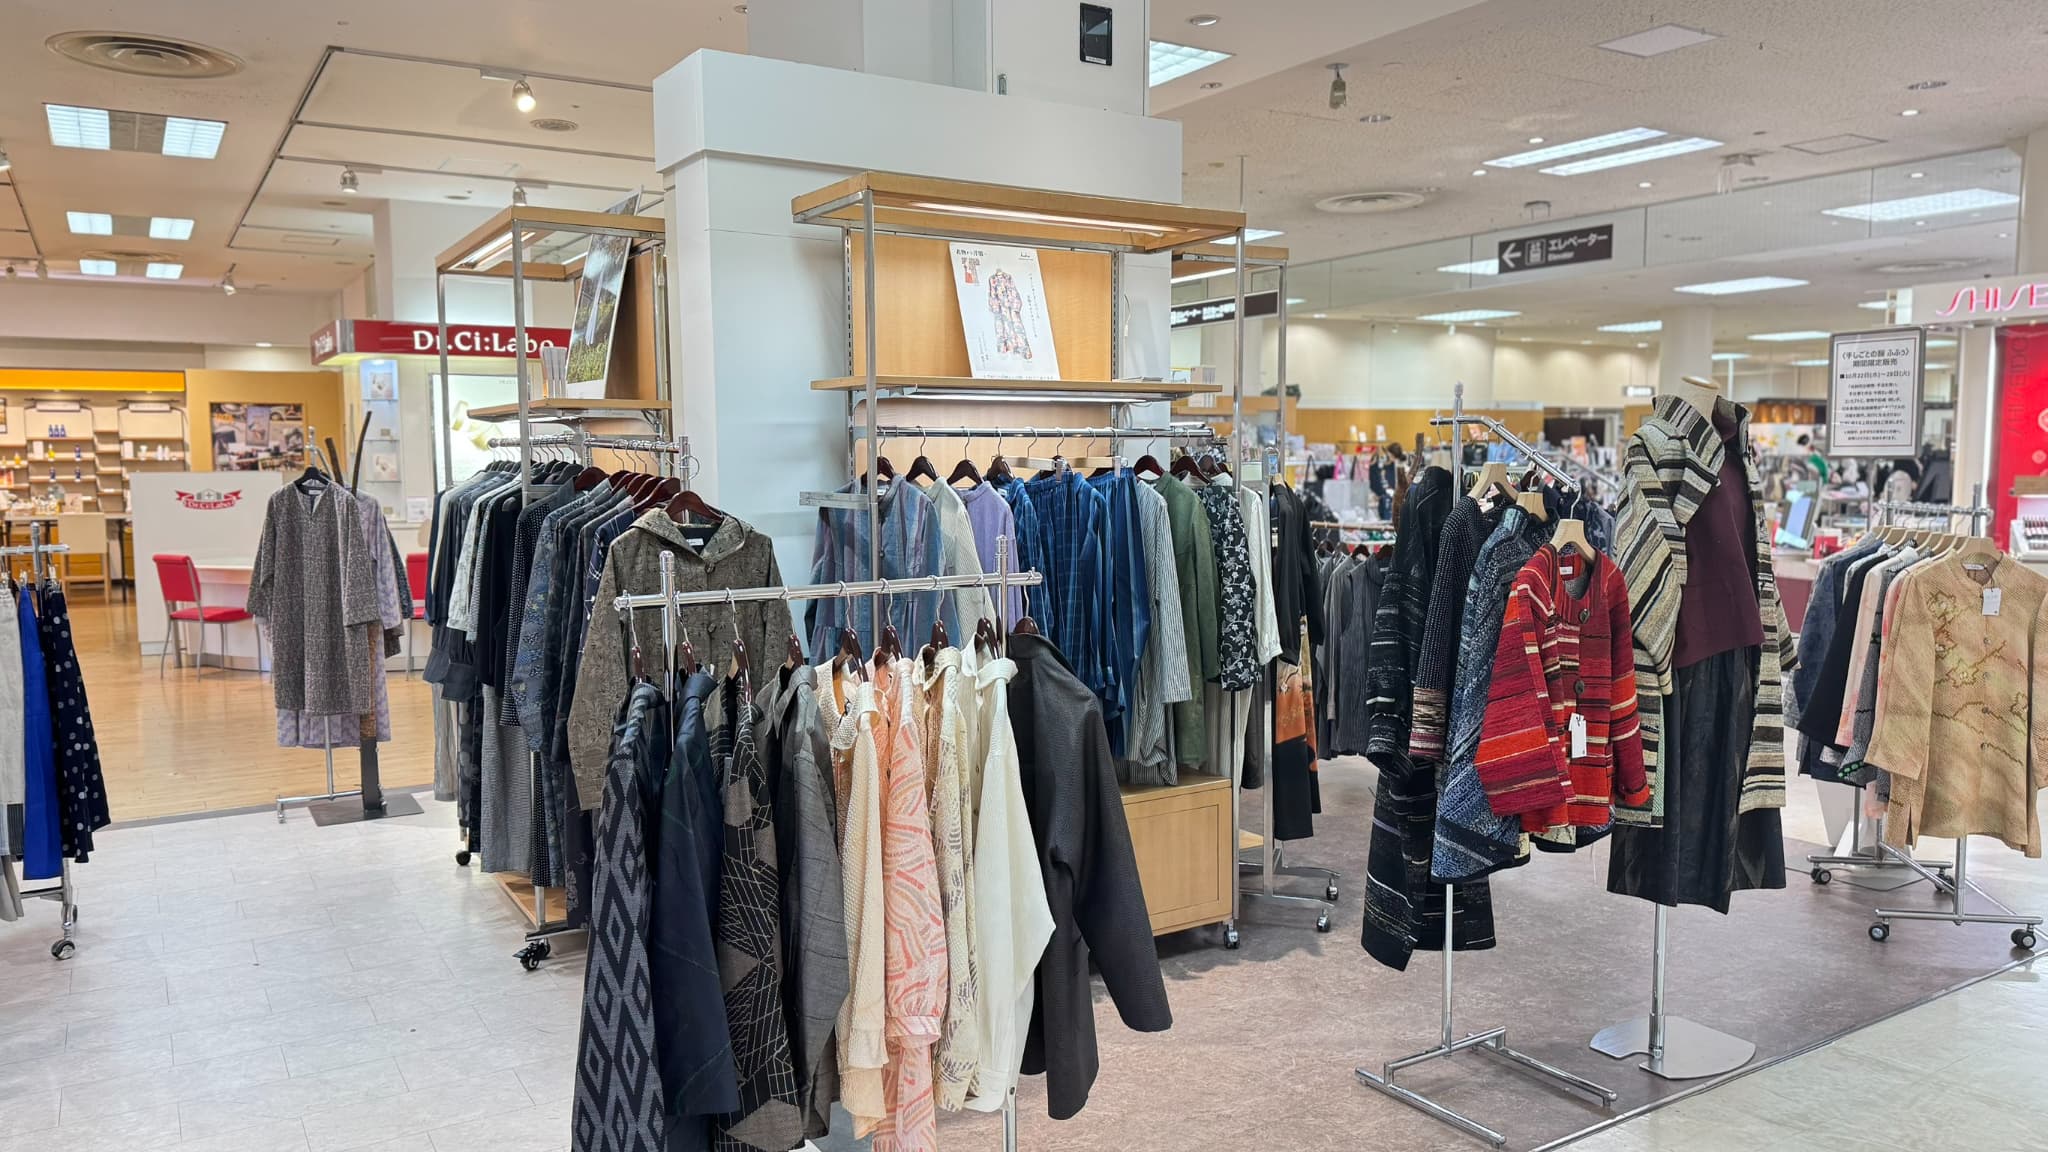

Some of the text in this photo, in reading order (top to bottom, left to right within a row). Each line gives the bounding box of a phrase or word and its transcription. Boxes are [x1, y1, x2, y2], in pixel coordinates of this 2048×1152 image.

[1548, 233, 1608, 251] エレベーター
